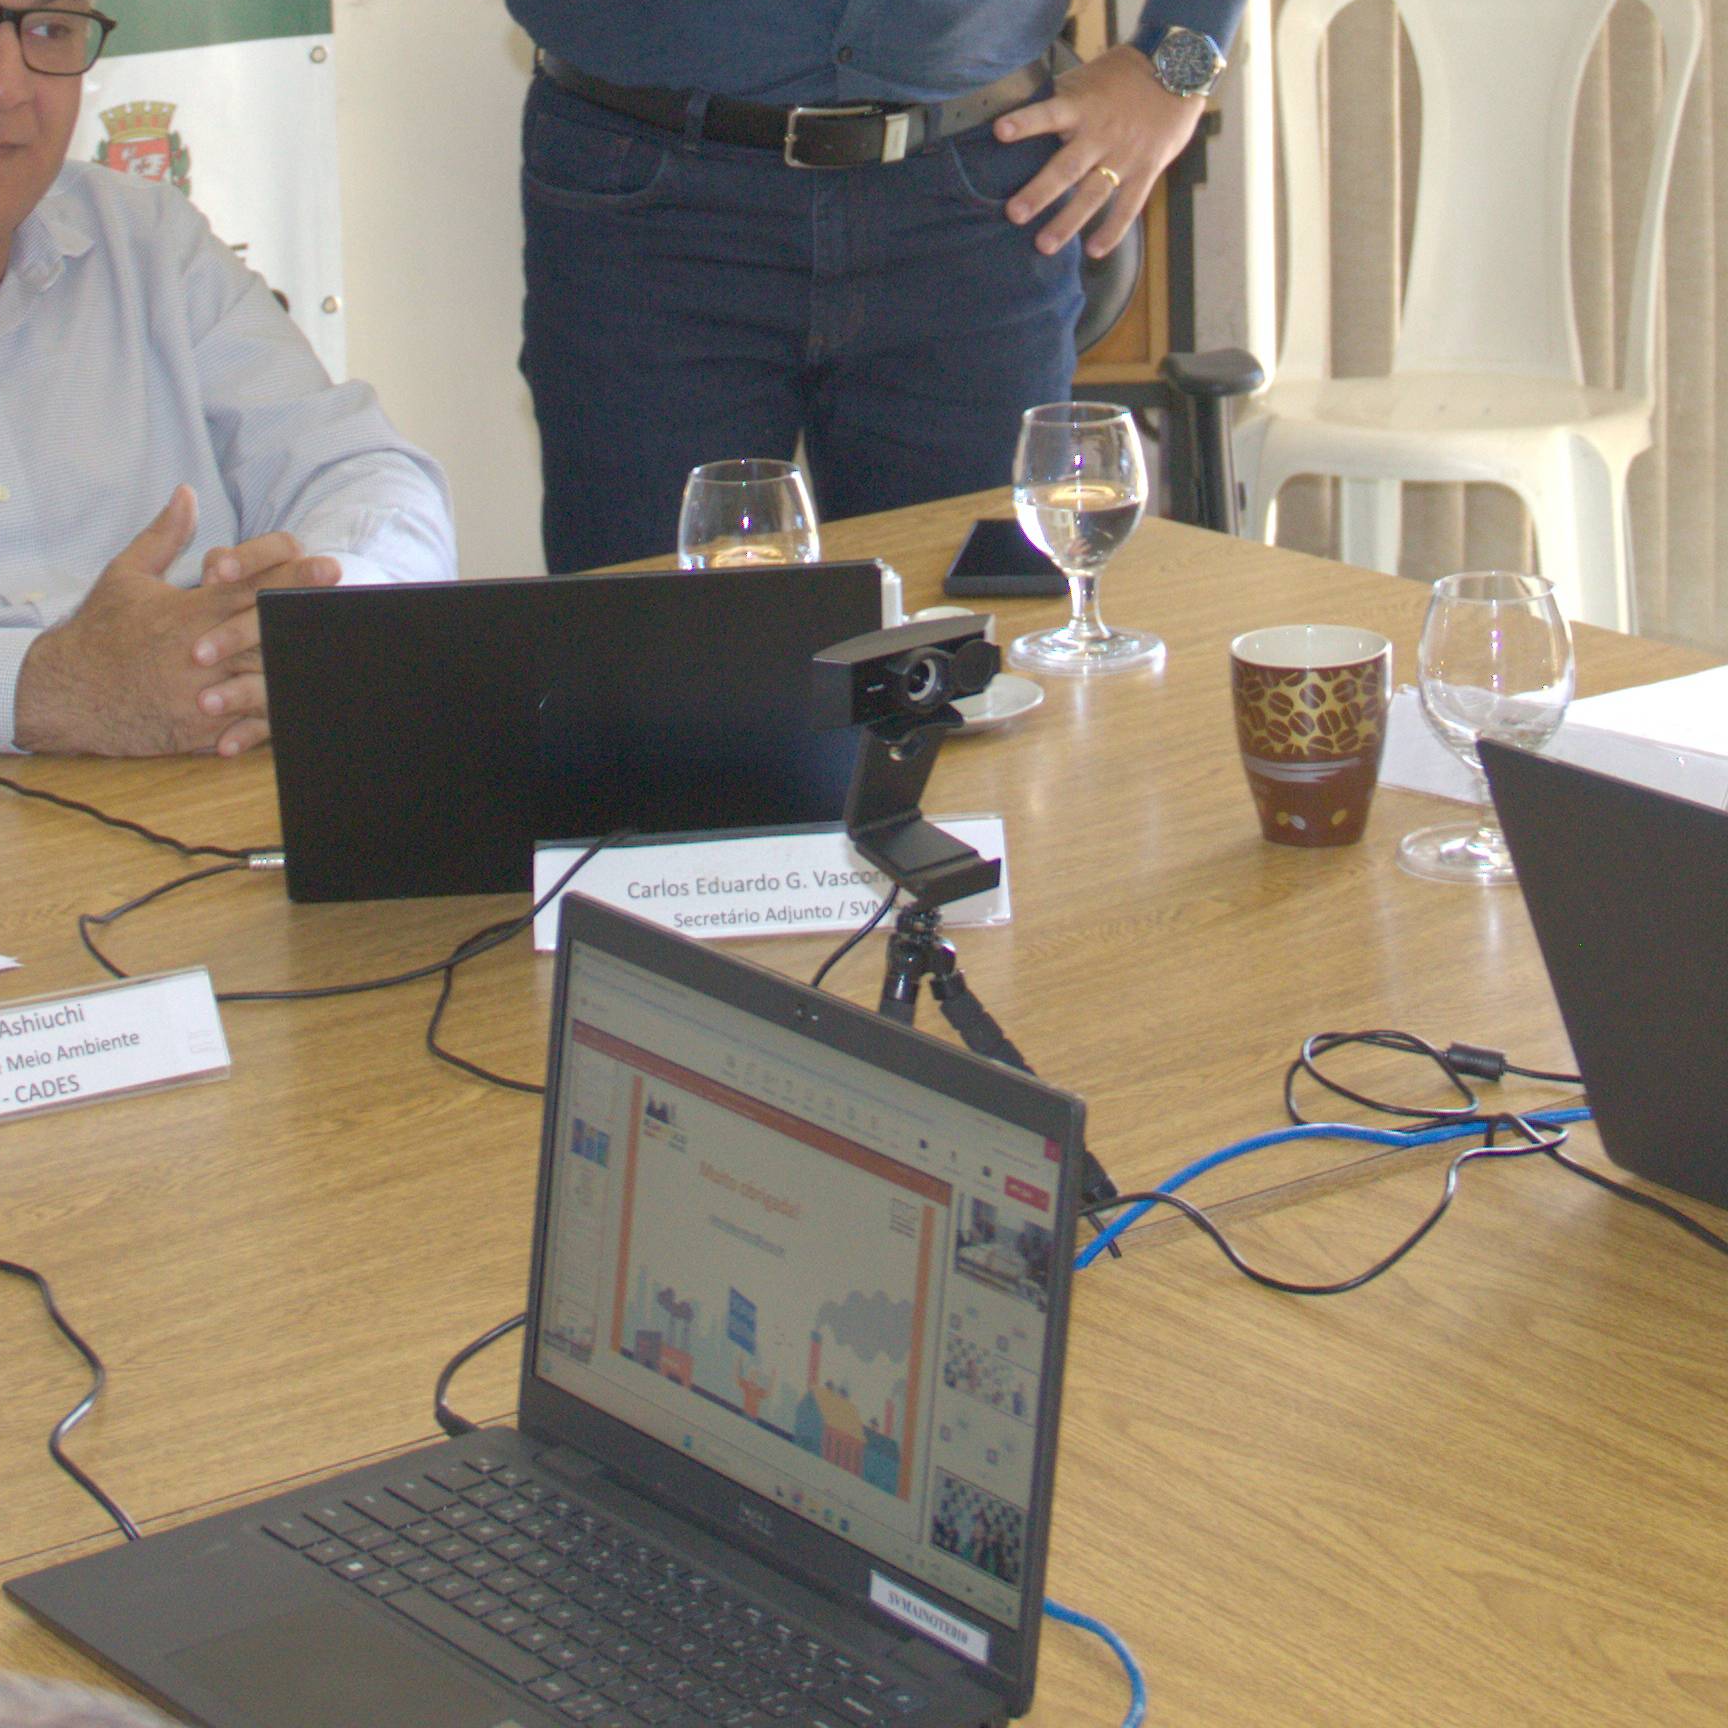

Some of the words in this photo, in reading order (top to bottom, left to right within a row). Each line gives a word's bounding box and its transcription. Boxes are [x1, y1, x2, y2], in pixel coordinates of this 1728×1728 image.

[627, 877, 689, 899] Carlos
[696, 872, 780, 896] Eduardo
[786, 871, 809, 890] G.
[673, 901, 760, 928] Secretário
[765, 902, 833, 925] Adjunto
[837, 900, 845, 919] /
[6, 1048, 52, 1071] Meio
[57, 1030, 141, 1062] Ambiente
[15, 1073, 81, 1104] CADES
